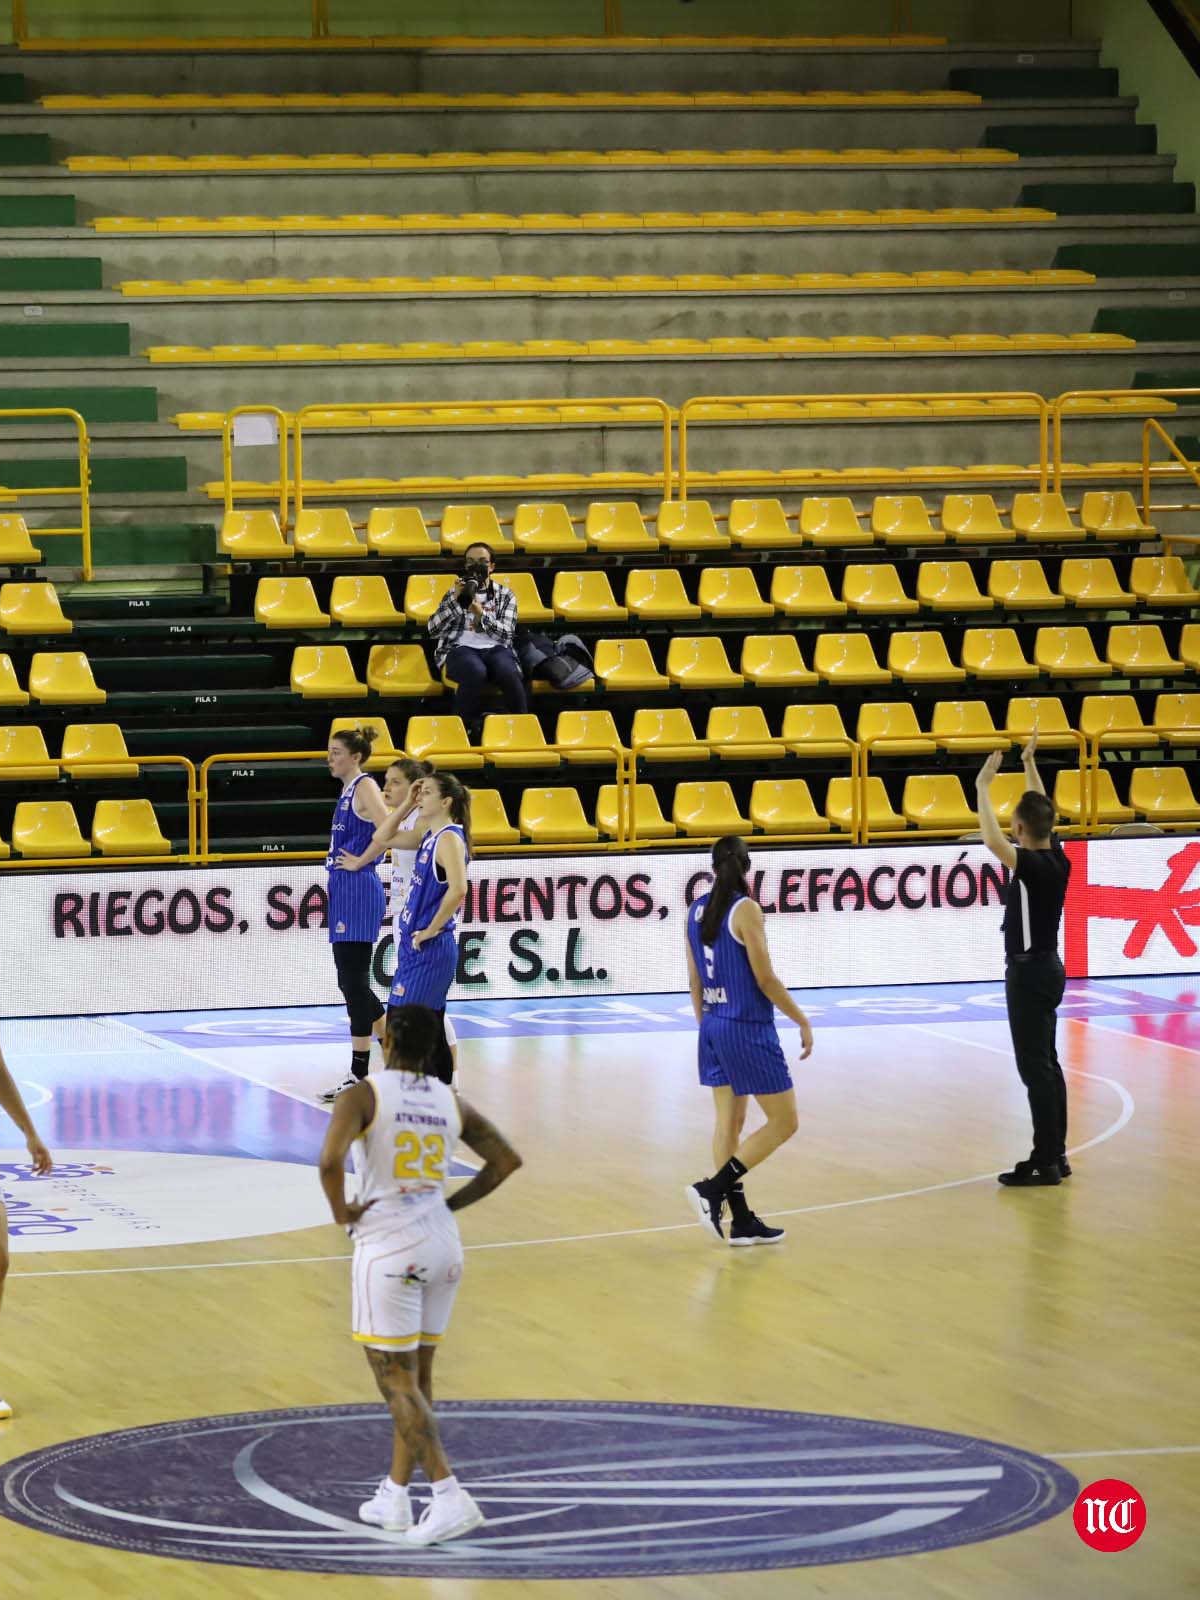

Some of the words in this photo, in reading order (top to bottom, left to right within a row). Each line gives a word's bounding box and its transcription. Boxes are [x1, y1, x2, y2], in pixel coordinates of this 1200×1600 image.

[54, 887, 249, 938] RIEGOS,
[266, 873, 669, 930] SAIENTOS,
[685, 851, 1011, 916] CLEFACCIÓN
[508, 927, 608, 982] S.L.
[393, 1130, 445, 1181] 22
